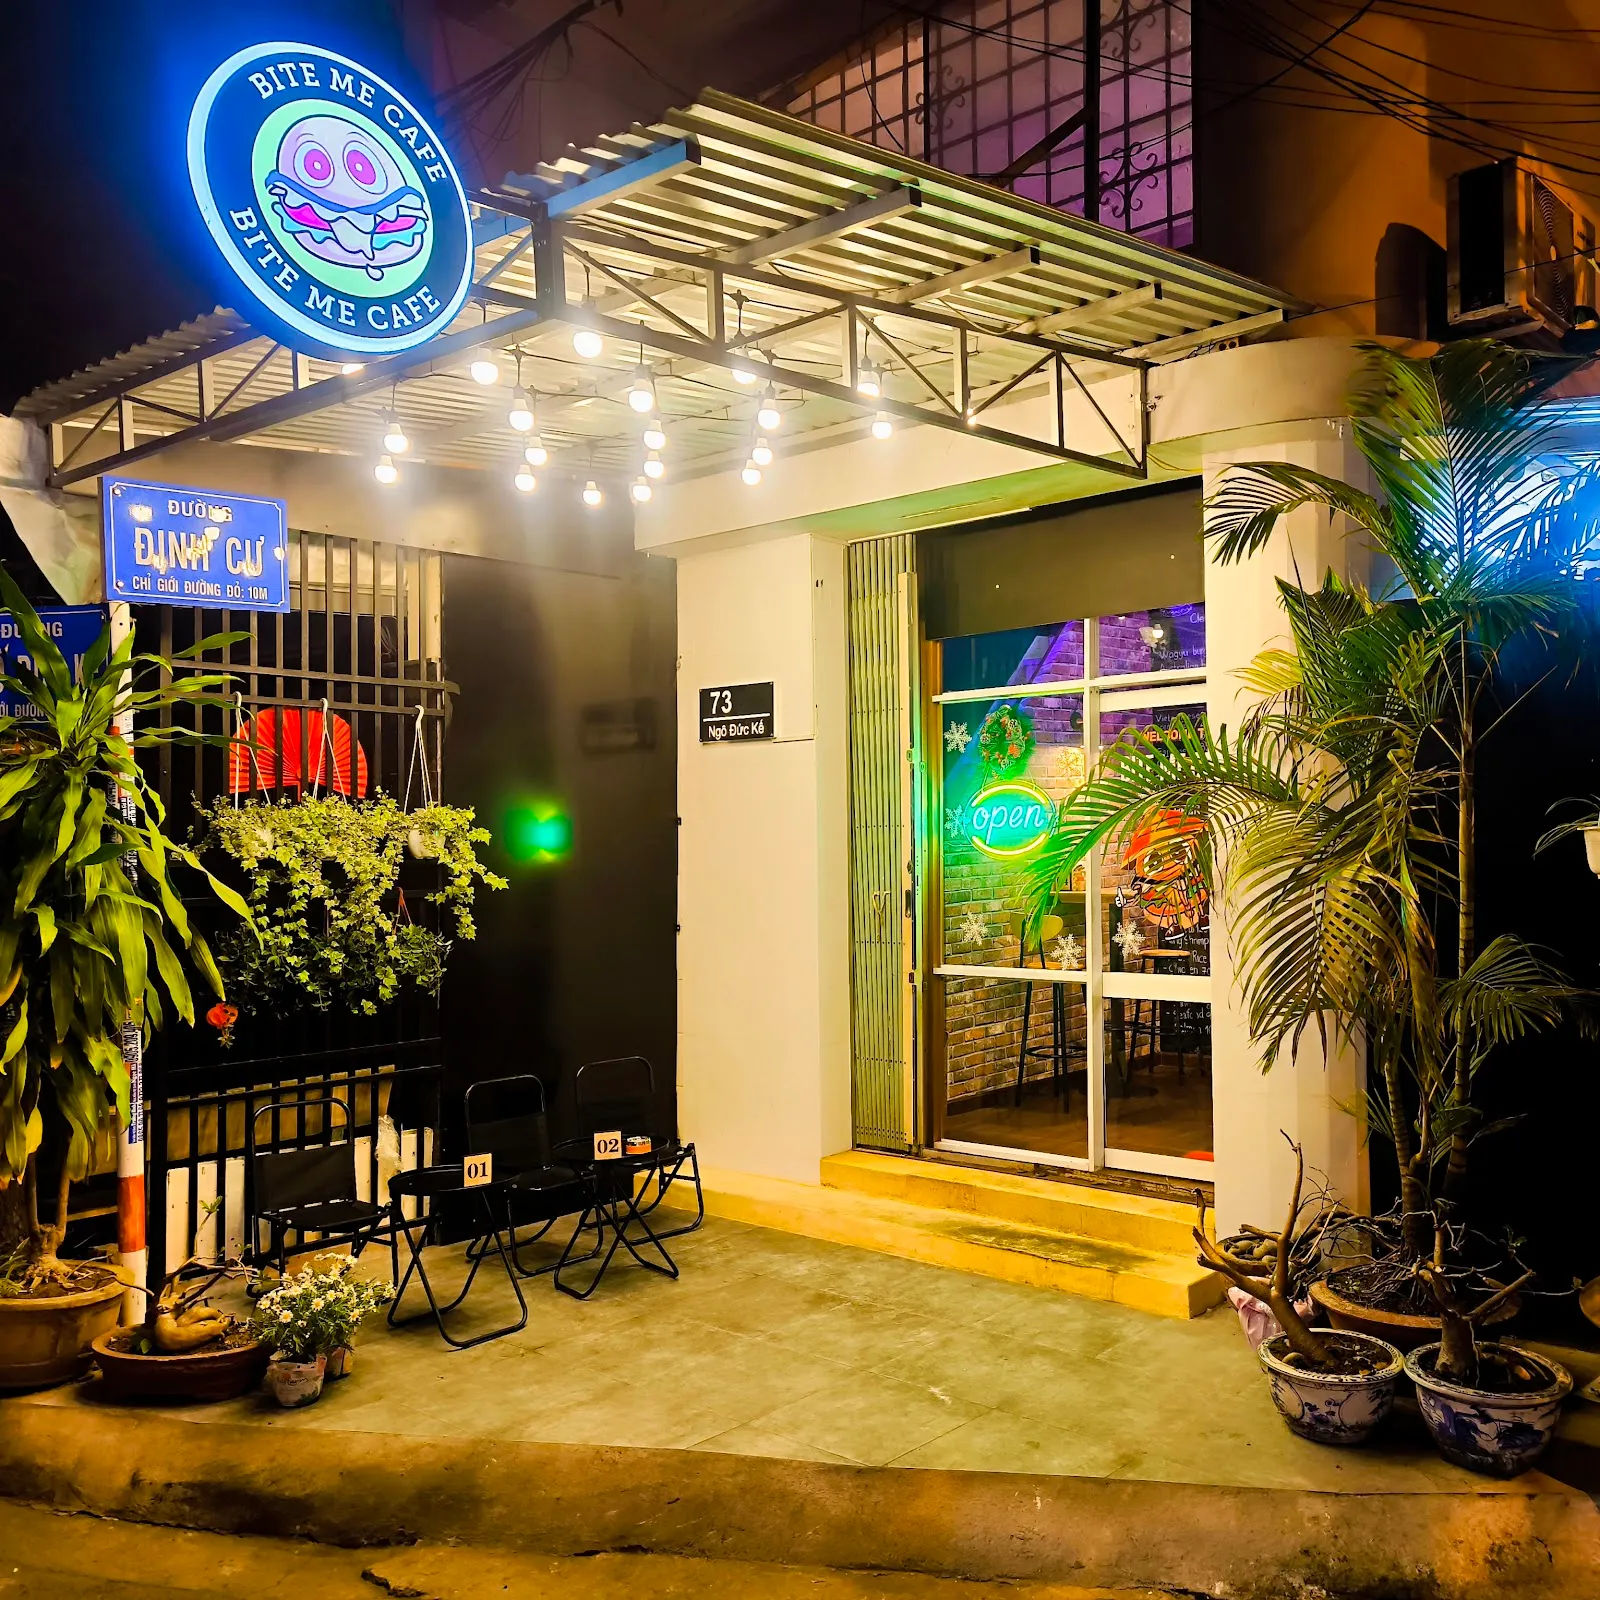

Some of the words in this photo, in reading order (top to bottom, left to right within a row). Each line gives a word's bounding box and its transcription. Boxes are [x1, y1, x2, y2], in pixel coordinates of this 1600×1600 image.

[248, 62, 320, 99] BITE
[329, 67, 376, 108] ME
[383, 105, 447, 182] CAFE
[229, 207, 300, 292] BITE
[304, 285, 356, 326] ME
[367, 286, 441, 330] CAFE
[133, 527, 210, 574] ĐỊNH
[225, 535, 265, 577] CƯ
[132, 573, 151, 590] CHỈ
[157, 576, 179, 593] GIỚI
[184, 579, 221, 597] ĐƯỜNG
[226, 581, 245, 598] ĐỎ:
[248, 586, 268, 600] 10M
[709, 690, 733, 715] 73
[708, 724, 728, 740] Ngô
[729, 723, 750, 737] Đức
[751, 719, 765, 735] Kế
[972, 804, 1045, 845] open
[597, 1138, 619, 1154] 02
[467, 1161, 489, 1179] 01
